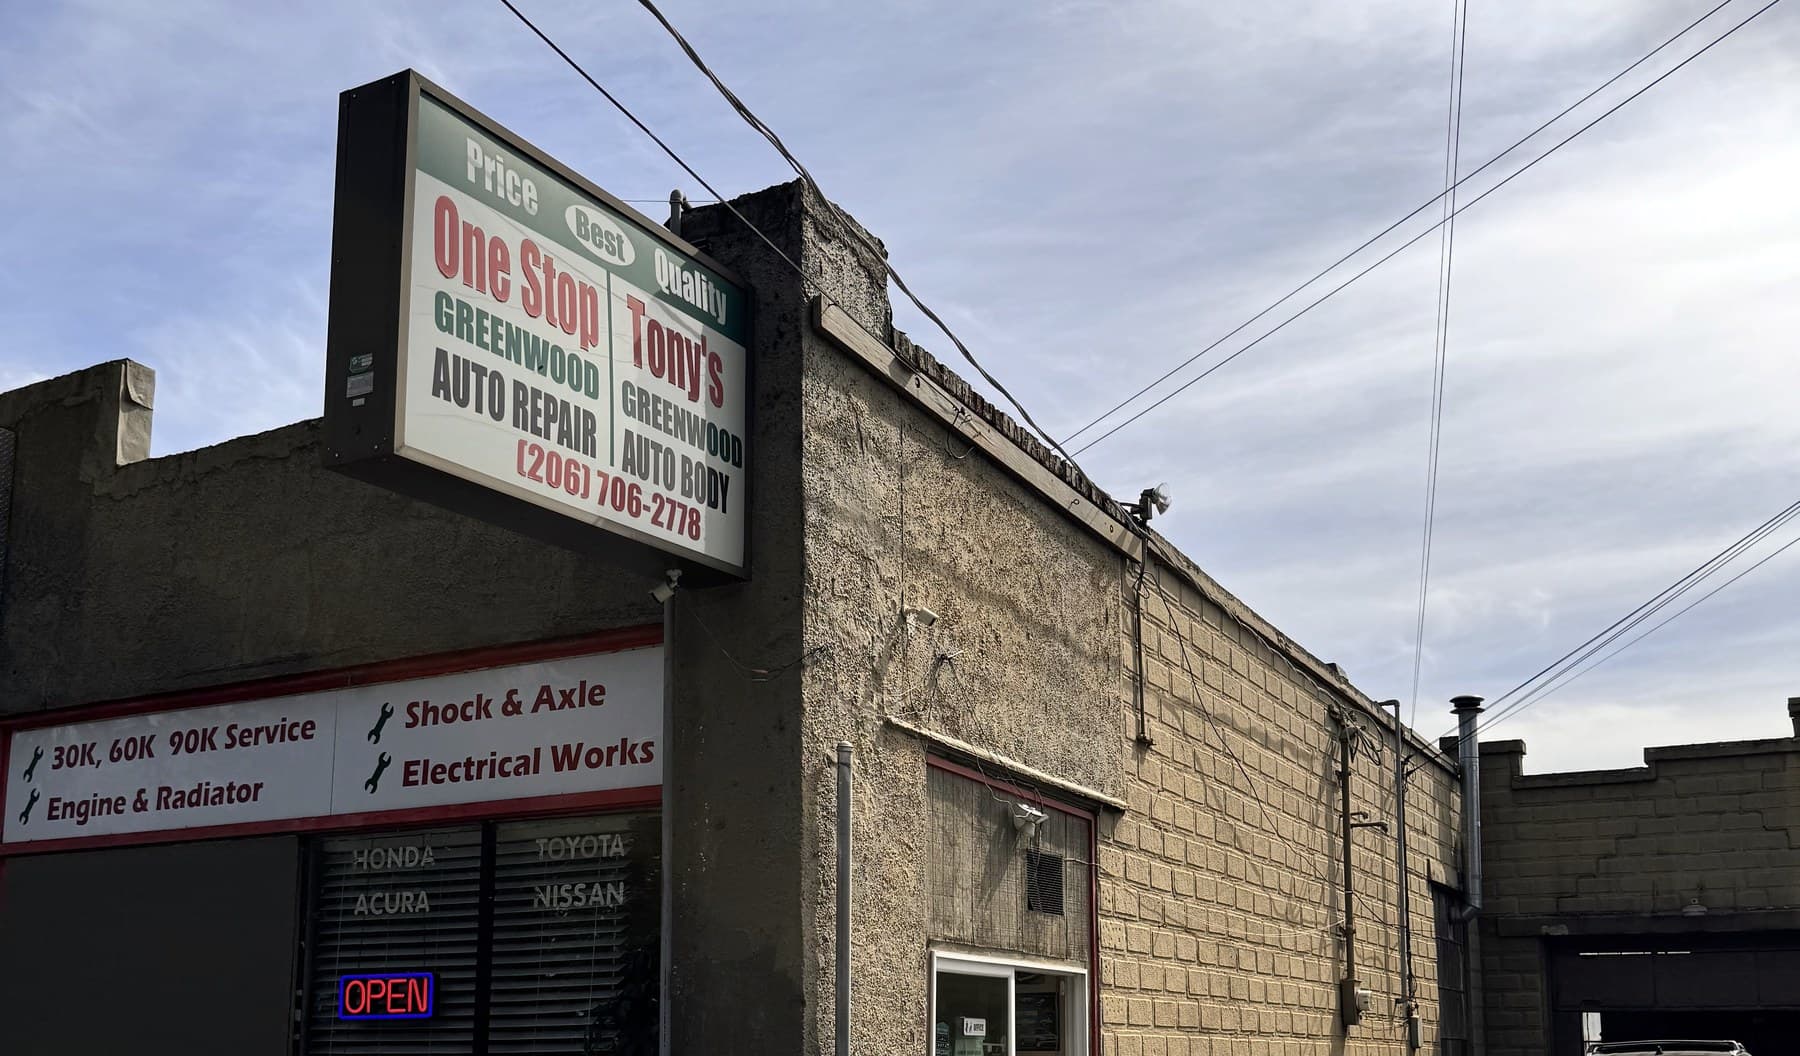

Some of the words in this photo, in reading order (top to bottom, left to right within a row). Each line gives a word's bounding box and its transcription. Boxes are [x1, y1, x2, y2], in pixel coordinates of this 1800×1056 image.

[466, 137, 539, 216] Price
[575, 207, 626, 262] Best
[434, 195, 511, 303] One
[520, 238, 600, 352] Stop
[654, 248, 728, 326] Quality
[434, 291, 600, 400] GREENWOOD
[626, 294, 724, 408] Tony's
[431, 347, 506, 422] AUTO
[512, 379, 597, 459] REPAIR
[621, 380, 743, 469] GREENWOOD
[517, 439, 591, 500] (206)
[597, 470, 702, 541] 706-2778
[621, 429, 676, 491] AUTO
[681, 454, 730, 514] BODY
[404, 693, 494, 728] Shock
[501, 689, 524, 717] &
[530, 680, 606, 713] Axle
[51, 742, 102, 770] 30K,
[109, 734, 157, 763] 60K
[169, 726, 220, 755] 90K
[224, 717, 316, 749] Service
[402, 748, 541, 787] Electrical
[551, 738, 655, 772] Works
[47, 793, 127, 825] Engine
[132, 788, 149, 812] &
[155, 780, 264, 810] Radiator
[353, 845, 435, 871] HONDA
[535, 834, 625, 860] TOYOTA
[354, 891, 430, 916] ACURA
[534, 882, 624, 908] NISSAN
[345, 978, 428, 1014] OPEN
